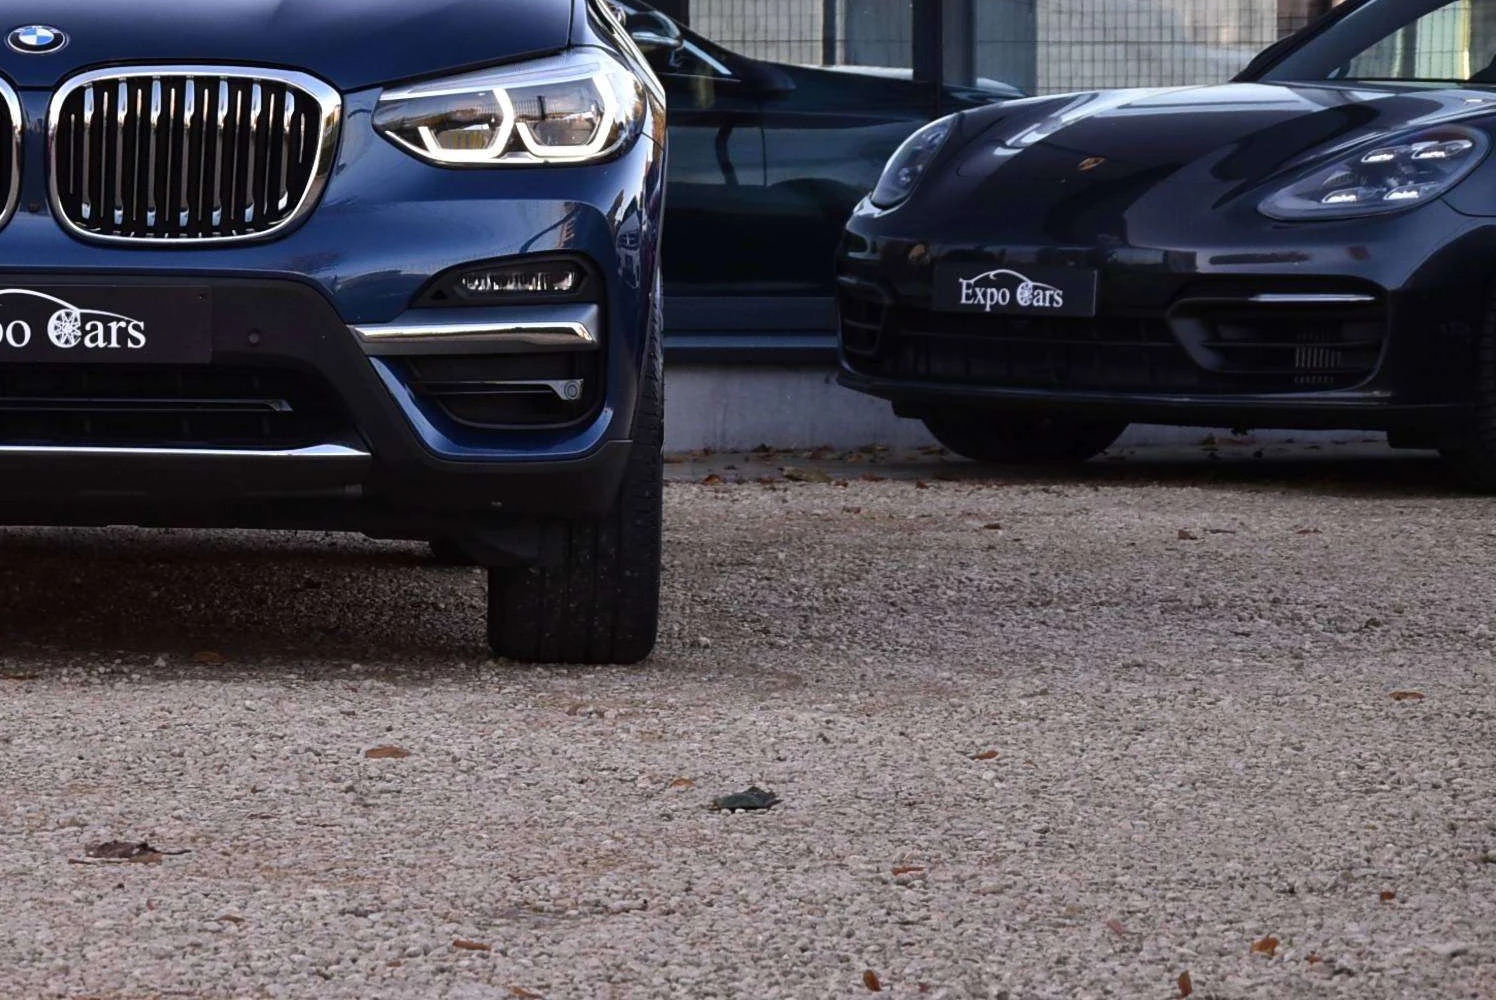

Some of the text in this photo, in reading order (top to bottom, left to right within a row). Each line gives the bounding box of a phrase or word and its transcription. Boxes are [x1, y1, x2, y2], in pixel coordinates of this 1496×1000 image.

[959, 278, 1064, 312] Expo Cars
[47, 308, 147, 349] Cars
